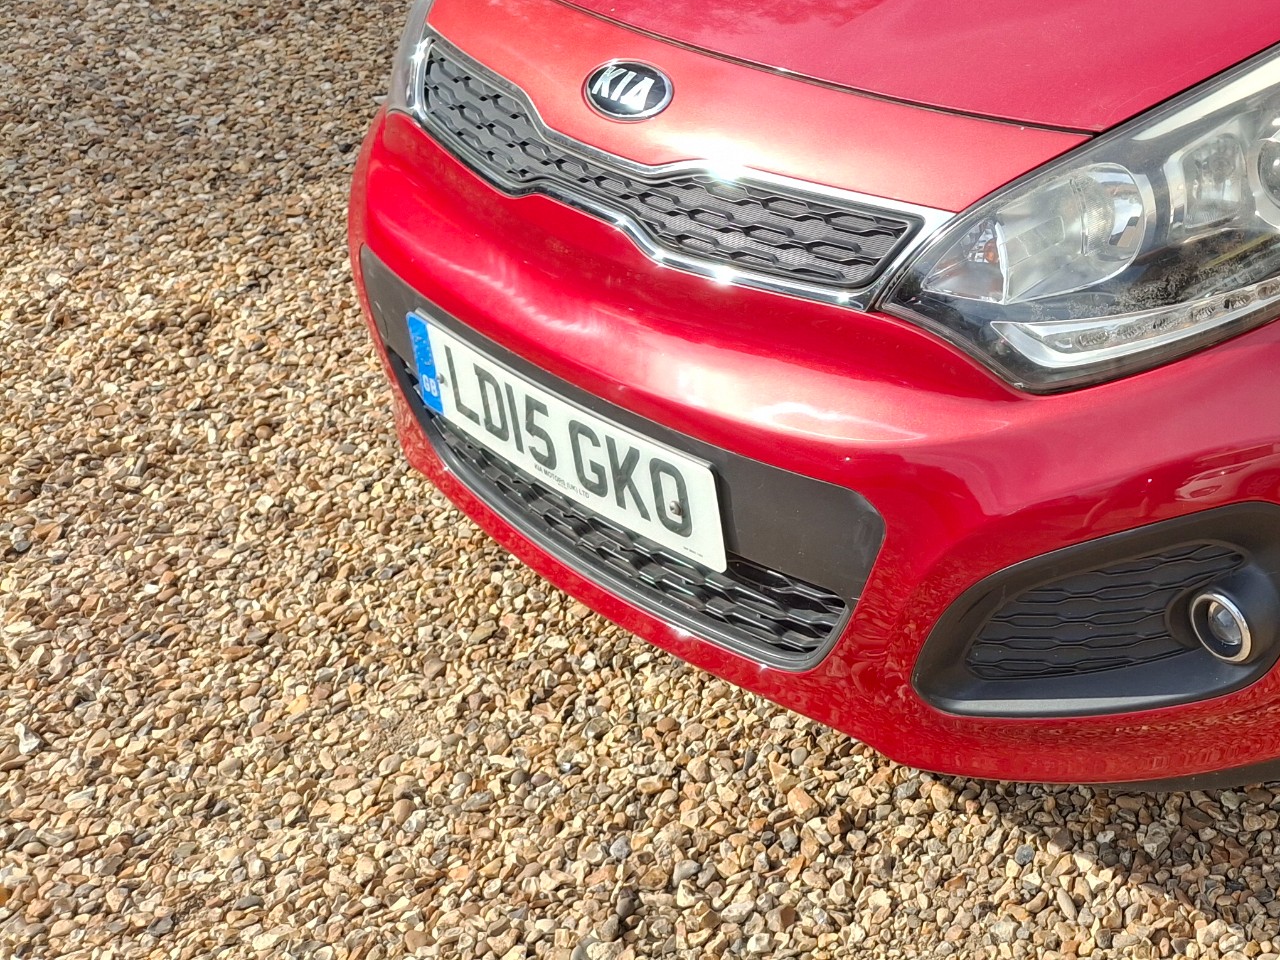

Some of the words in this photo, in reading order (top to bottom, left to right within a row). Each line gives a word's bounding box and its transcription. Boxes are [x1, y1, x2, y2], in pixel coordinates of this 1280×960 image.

[591, 66, 656, 111] KIA
[422, 373, 439, 398] GB
[444, 344, 558, 471] LD15
[568, 419, 693, 538] GKO
